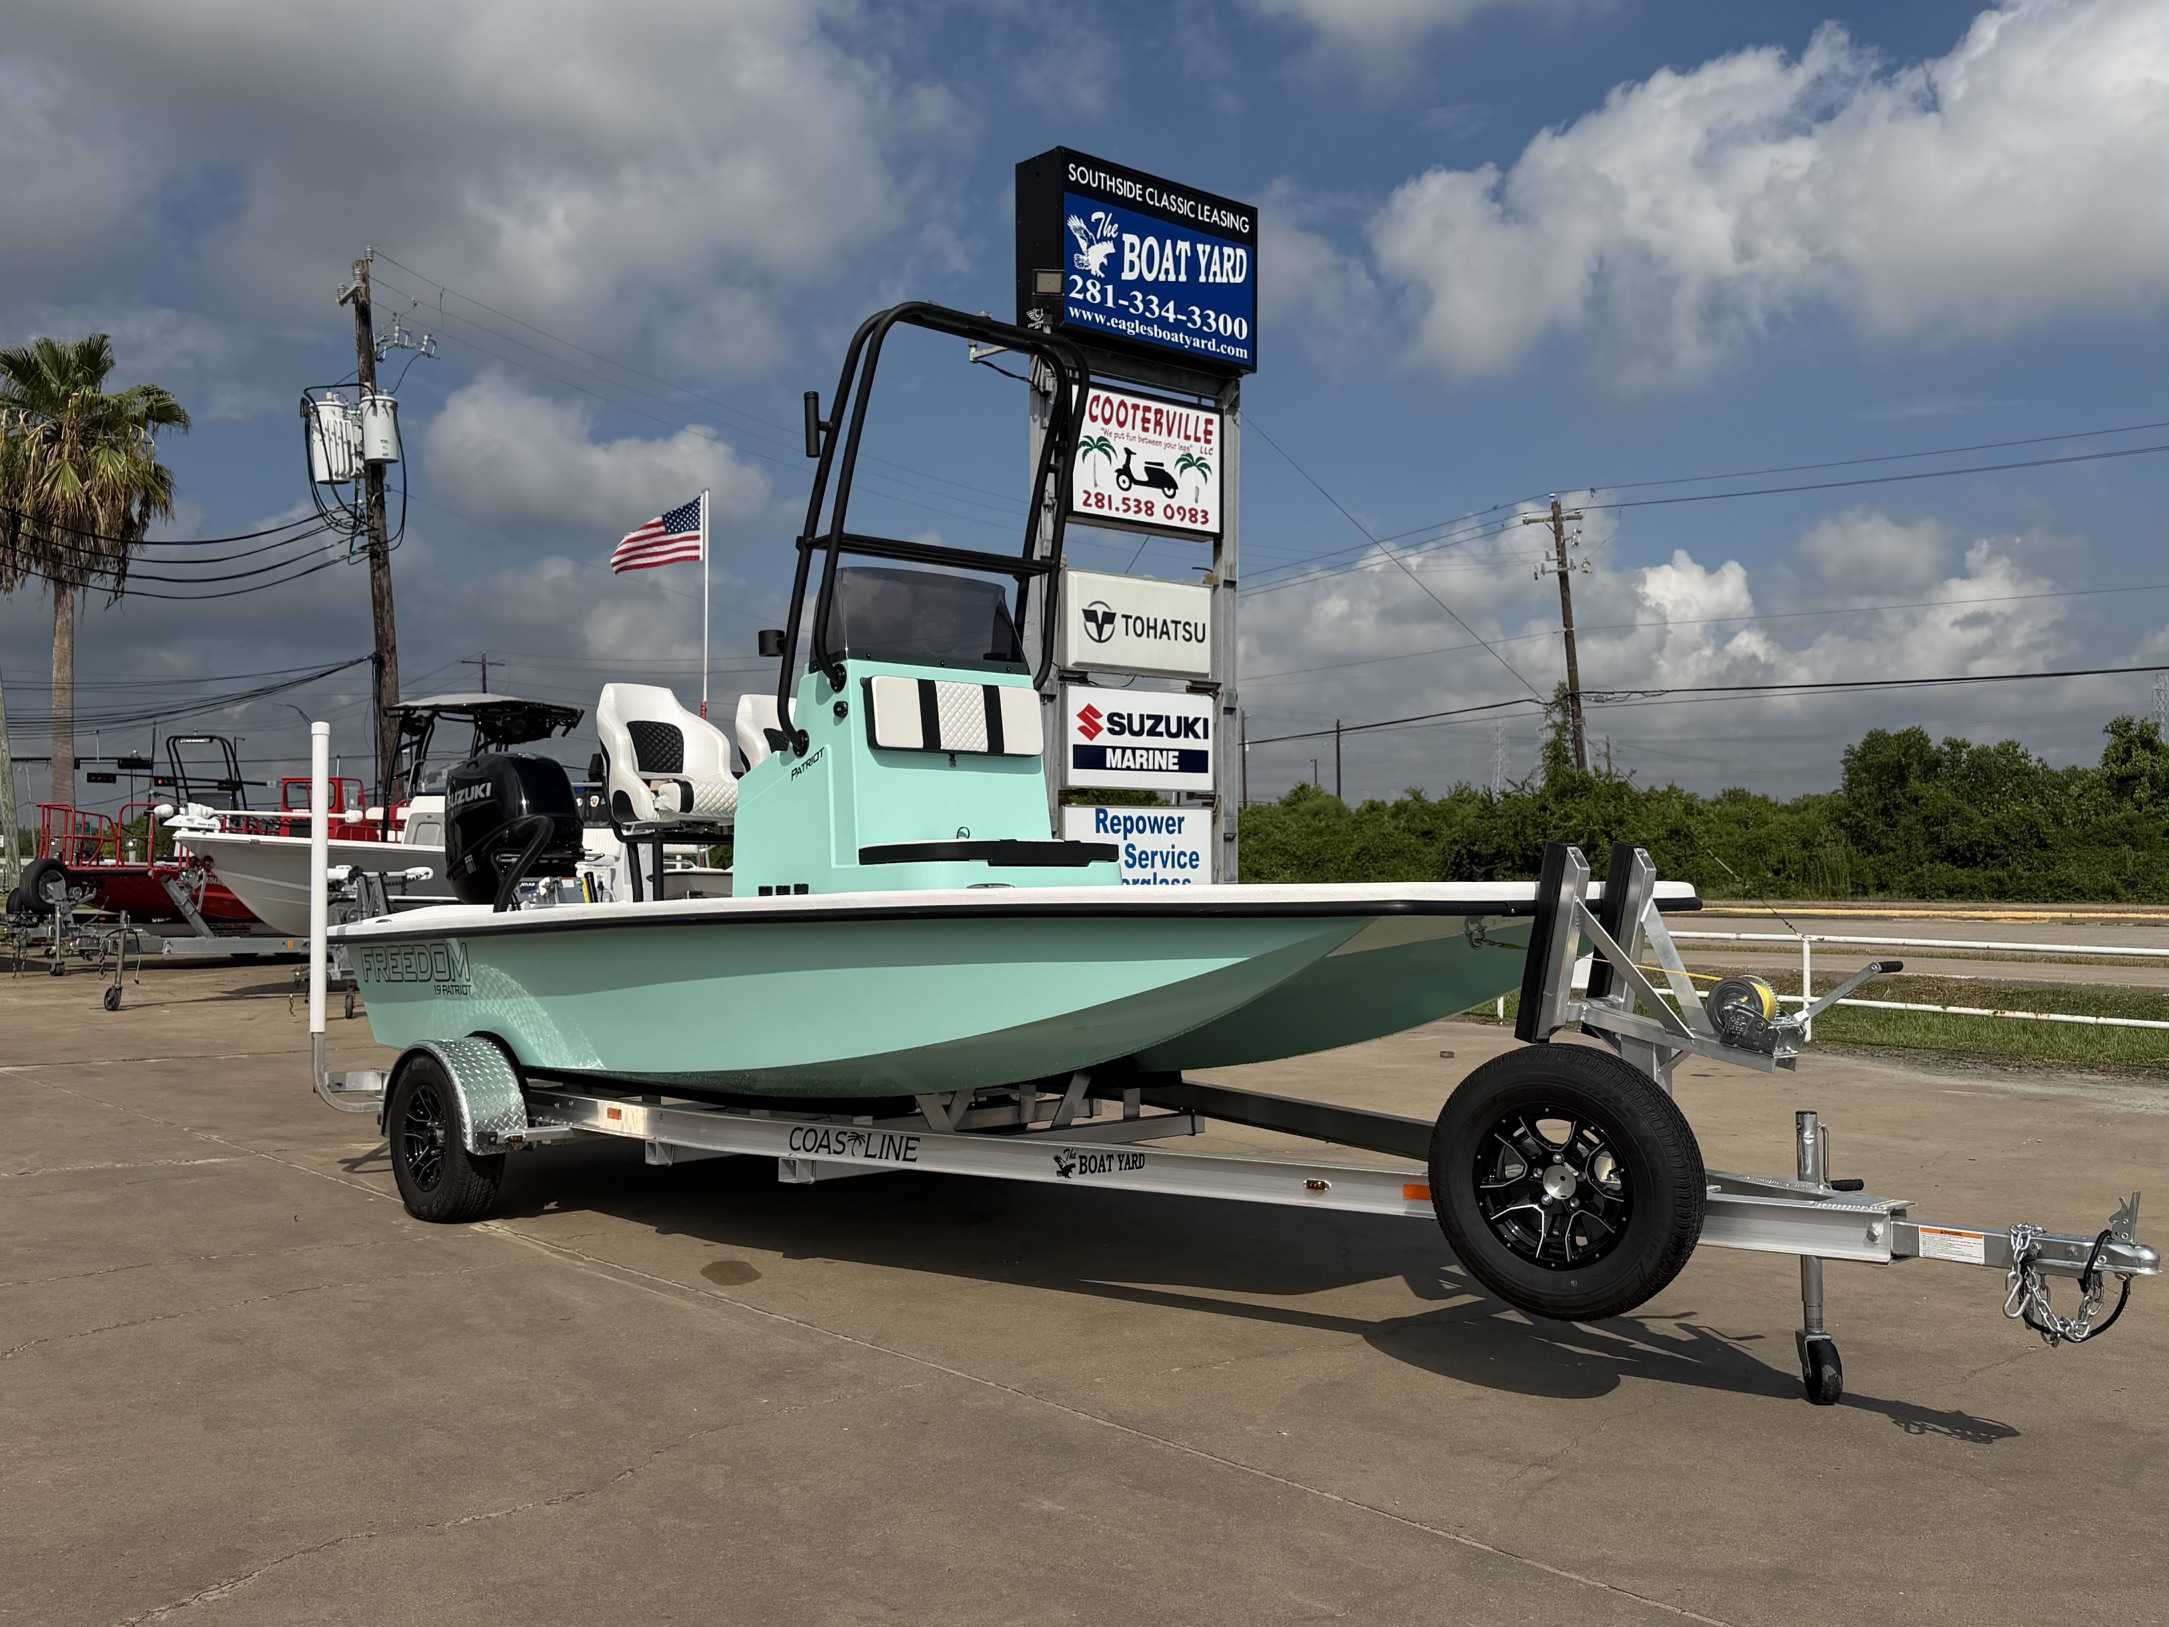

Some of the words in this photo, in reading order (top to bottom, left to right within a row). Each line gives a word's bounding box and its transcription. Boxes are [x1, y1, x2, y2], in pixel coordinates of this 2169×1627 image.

[1068, 163, 1143, 201] SOUTHSIDE
[1145, 188, 1195, 218] CLASSIC
[1198, 203, 1250, 233] LEASING
[1091, 211, 1119, 239] The
[1121, 233, 1191, 282] BOAT
[1196, 243, 1248, 284] YARD
[1068, 275, 1248, 340] 281-334-3300
[1068, 305, 1248, 359] www.eaglesboatyard.com
[1088, 394, 1214, 445] COOTERVILLE
[1200, 446, 1214, 456] LLC
[1082, 490, 1155, 517] 281.538
[1163, 503, 1209, 525] 0983
[1121, 614, 1206, 644] TOHATSU
[1106, 712, 1209, 740] SUZUKI
[791, 746, 825, 781] PATRIOT
[1105, 748, 1180, 771] MARINE
[1095, 808, 1185, 840] Repower
[1124, 843, 1200, 869] Service
[360, 942, 471, 983] FREEDOM
[433, 985, 441, 996] 19
[442, 984, 472, 996] PATRIOT
[1079, 1154, 1114, 1175] BOAT
[1117, 1153, 1145, 1171] YARD
